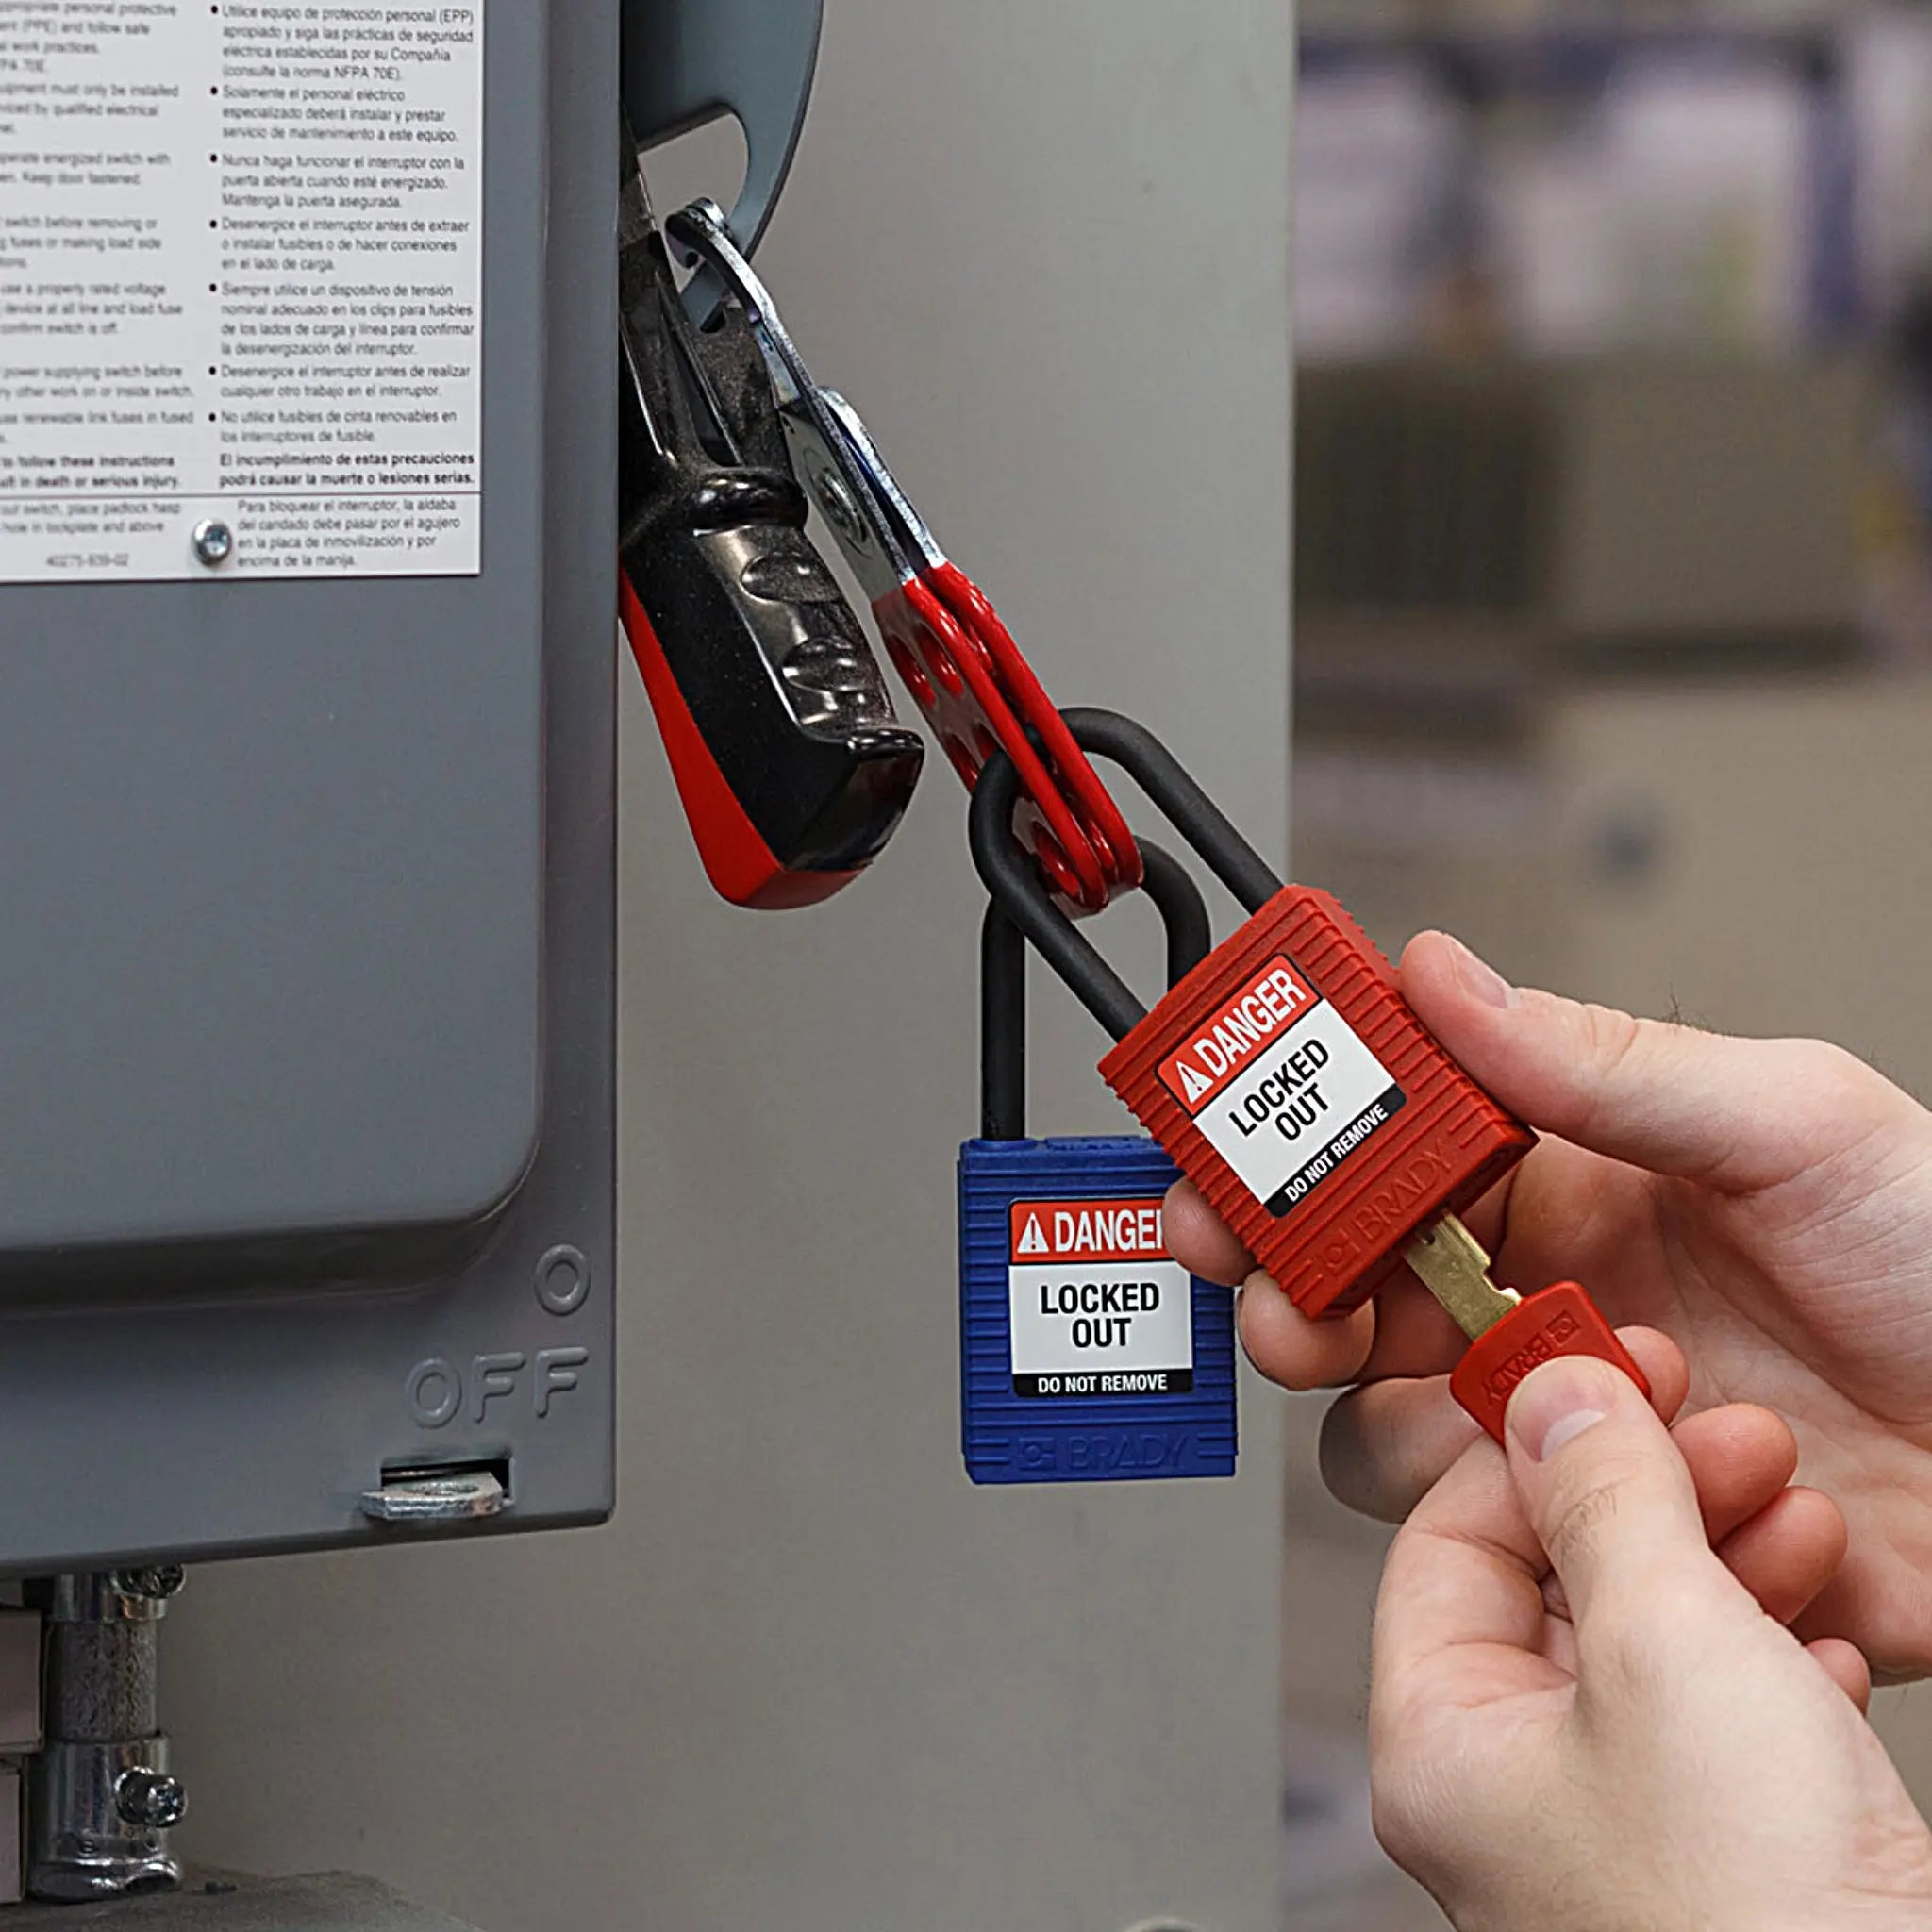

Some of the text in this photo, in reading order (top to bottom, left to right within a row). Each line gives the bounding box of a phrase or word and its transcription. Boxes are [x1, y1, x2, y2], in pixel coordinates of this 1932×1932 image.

[385, 9, 436, 23] personal
[439, 9, 473, 25] (EPP)
[294, 27, 319, 42] siga
[322, 27, 340, 40] las
[416, 30, 473, 44] seguridad
[351, 49, 370, 61] por
[292, 67, 330, 78] norma
[334, 65, 369, 78] NFPA
[372, 66, 402, 80] 70E).
[302, 88, 353, 101] personal
[349, 108, 391, 121] instalar
[405, 109, 445, 123] prestar
[289, 127, 375, 140] mantenimiento
[388, 129, 413, 141] este
[416, 130, 458, 143] equipo.
[296, 155, 350, 168] funcionar
[367, 157, 426, 170] interruptor
[428, 158, 450, 169] con
[453, 157, 464, 170] la
[306, 175, 349, 188] cuando
[380, 176, 448, 191] energizado.
[297, 195, 335, 208] puerta
[338, 196, 403, 210] asegurada.
[312, 219, 373, 233] interruptor
[375, 220, 408, 231] antes
[428, 221, 469, 232] extraer
[355, 239, 388, 251] hacer
[391, 240, 457, 251] conexiones
[328, 285, 390, 297] dispositivo
[350, 304, 366, 316] los
[369, 304, 396, 318] clips
[399, 306, 425, 317] para
[428, 304, 473, 316] fusibles
[312, 325, 345, 338] carga
[391, 325, 417, 337] para
[420, 323, 474, 335] confirmar
[333, 342, 352, 355] del
[355, 342, 417, 357] interruptor.
[312, 366, 372, 378] interruptor
[375, 366, 407, 377] antes
[427, 365, 470, 377] realizar
[304, 385, 344, 399] trabajo
[379, 385, 442, 398] interruptor.
[343, 410, 372, 423] cinta
[375, 410, 438, 423] renovables
[441, 412, 456, 422] en
[354, 454, 388, 464] estas
[391, 454, 474, 466] precauciones
[321, 474, 363, 485] muerte
[378, 473, 430, 484] lesiones
[434, 473, 475, 484] serias.
[337, 500, 399, 513] interruptor,
[417, 498, 456, 510] aldaba
[312, 518, 341, 530] debe
[344, 519, 377, 531] pasar
[380, 519, 400, 531] por
[417, 518, 460, 531] agujero
[416, 537, 436, 548] por
[315, 554, 358, 567] manija.
[1194, 968, 1306, 1074] DANGER
[1228, 1038, 1329, 1137] LOCKED
[1275, 1085, 1329, 1141] OUT
[1284, 1104, 1389, 1204] DO NOT REMOVE
[1354, 1141, 1455, 1242] BRADY
[1041, 1283, 1159, 1314] LOCKED
[1073, 1318, 1131, 1348] OUT
[405, 1346, 589, 1429] OFF
[1039, 1374, 1167, 1393] DO NOT REMOVE
[1067, 1435, 1188, 1469] BRADY
